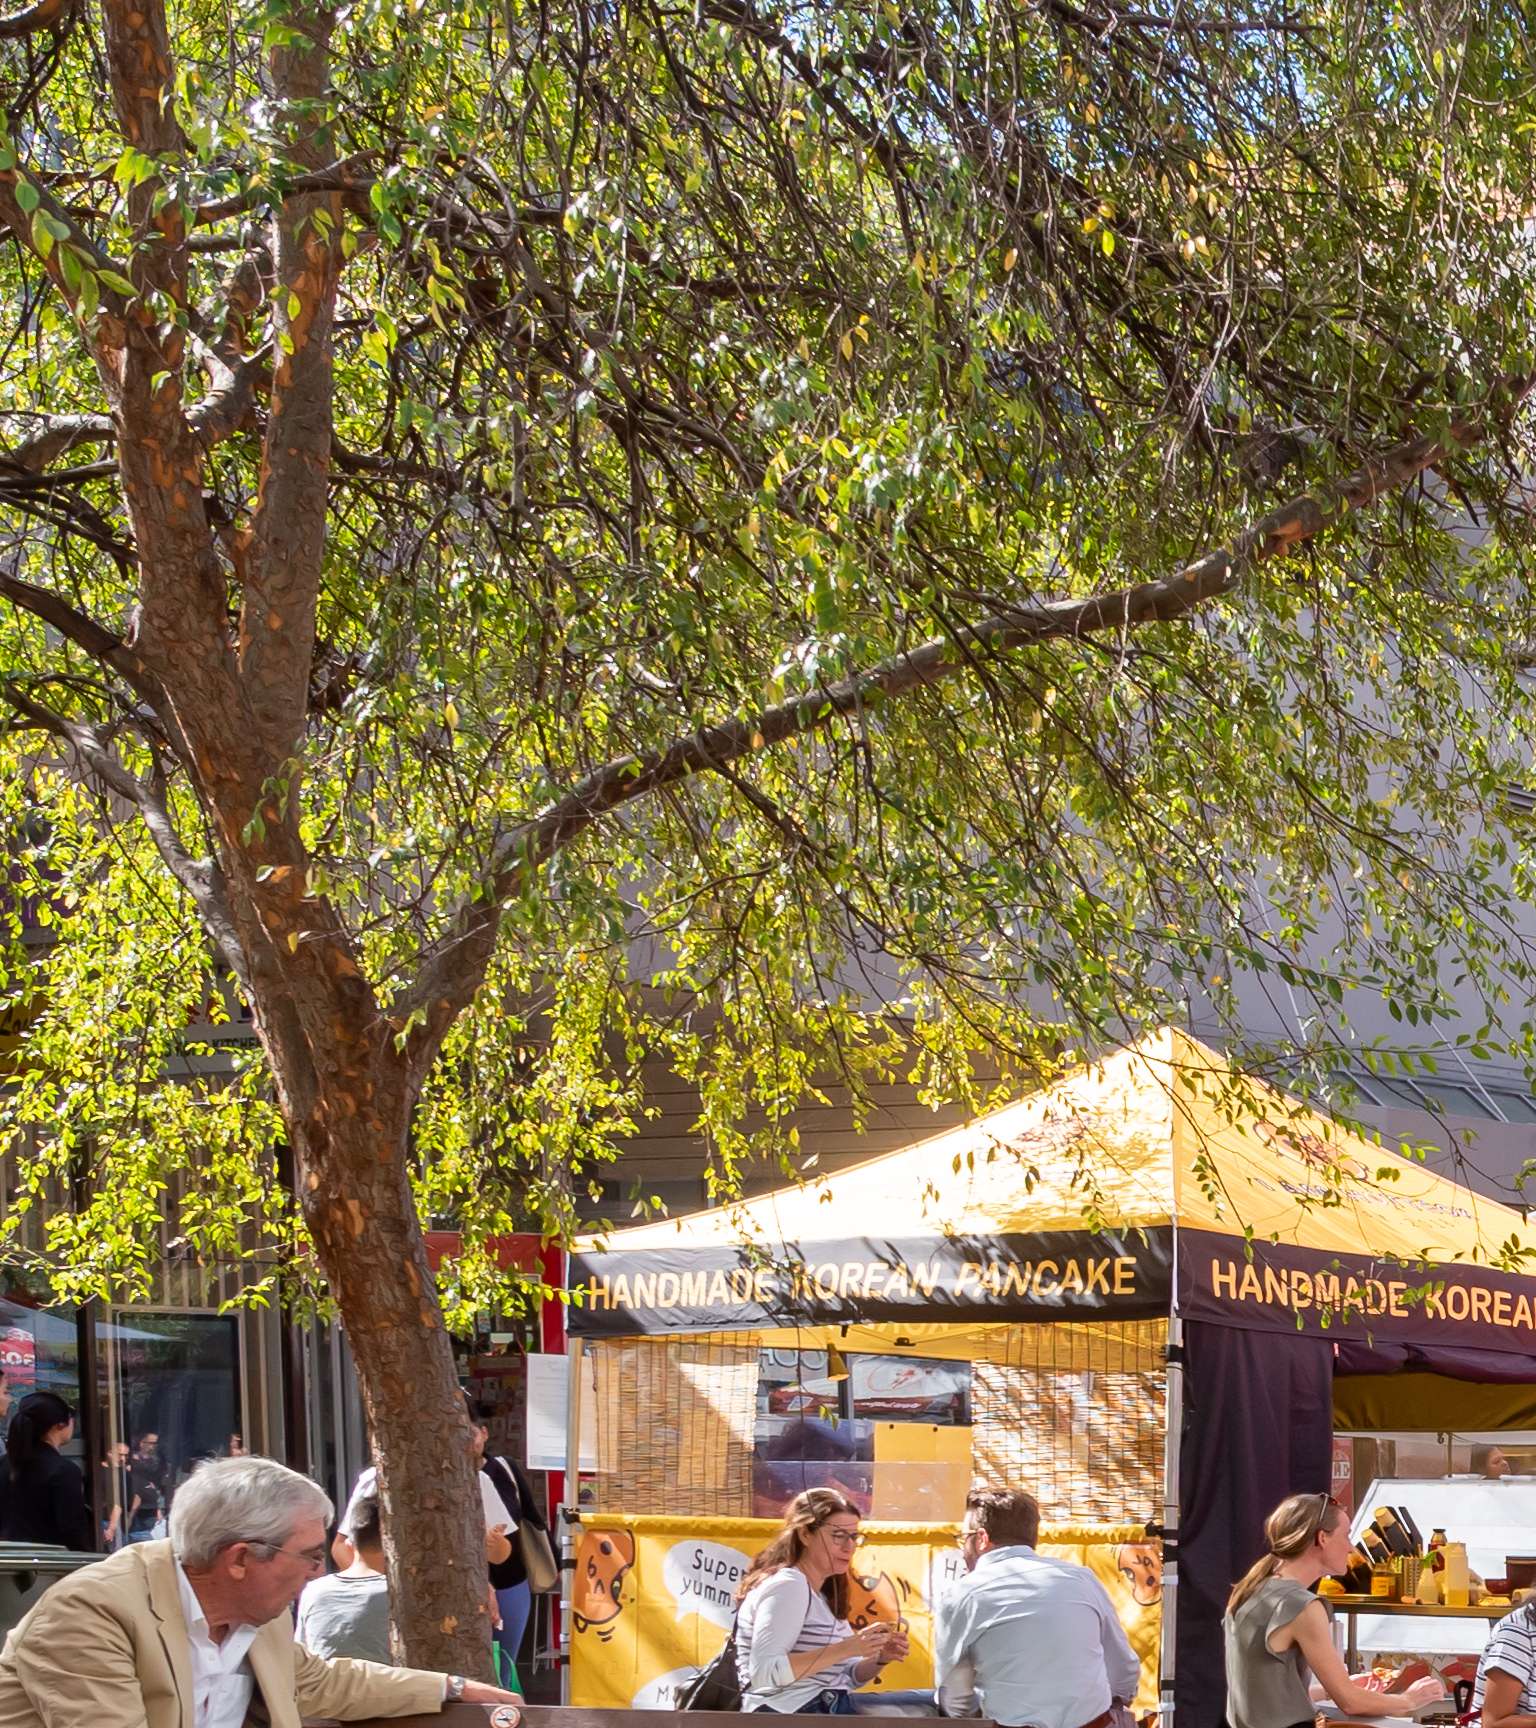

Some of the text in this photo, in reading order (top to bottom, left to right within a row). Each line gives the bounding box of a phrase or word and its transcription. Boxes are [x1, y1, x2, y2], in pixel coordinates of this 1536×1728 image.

[588, 1256, 1137, 1311] HANDMADE KOREAN PANCAKE
[1211, 1258, 1408, 1318] HANDMADE
